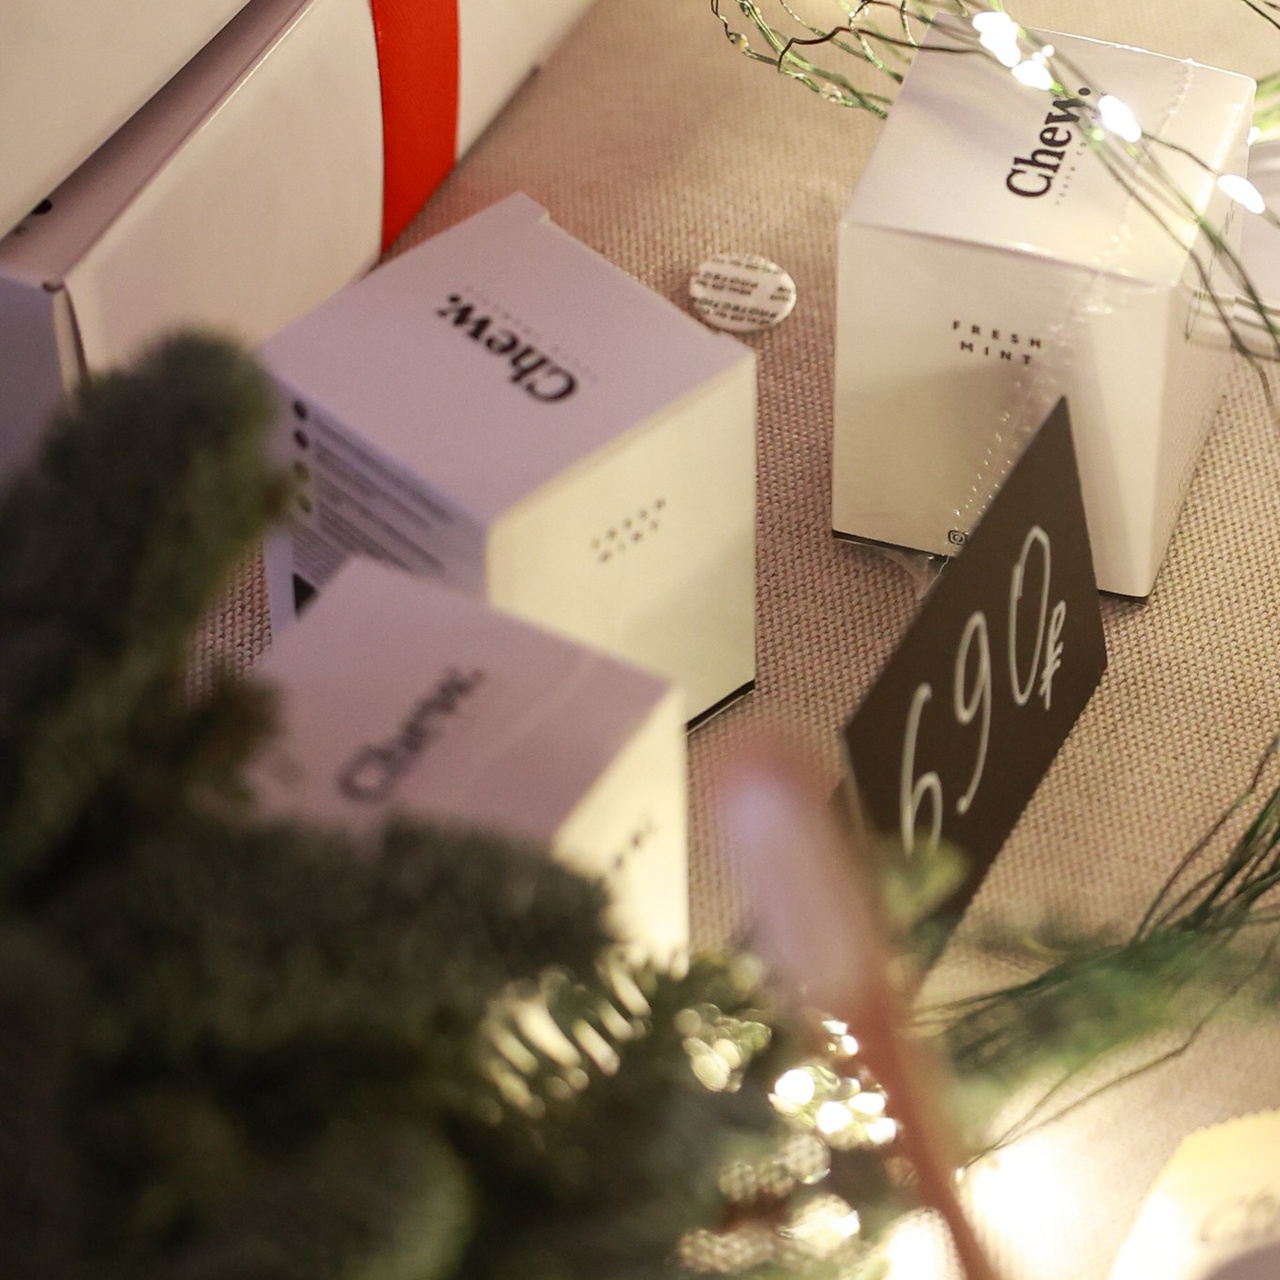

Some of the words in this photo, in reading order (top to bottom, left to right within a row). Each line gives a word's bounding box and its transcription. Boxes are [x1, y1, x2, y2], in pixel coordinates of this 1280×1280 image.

[437, 293, 577, 404] Chew.
[952, 320, 1042, 349] FRESH
[960, 340, 1032, 366] MINT
